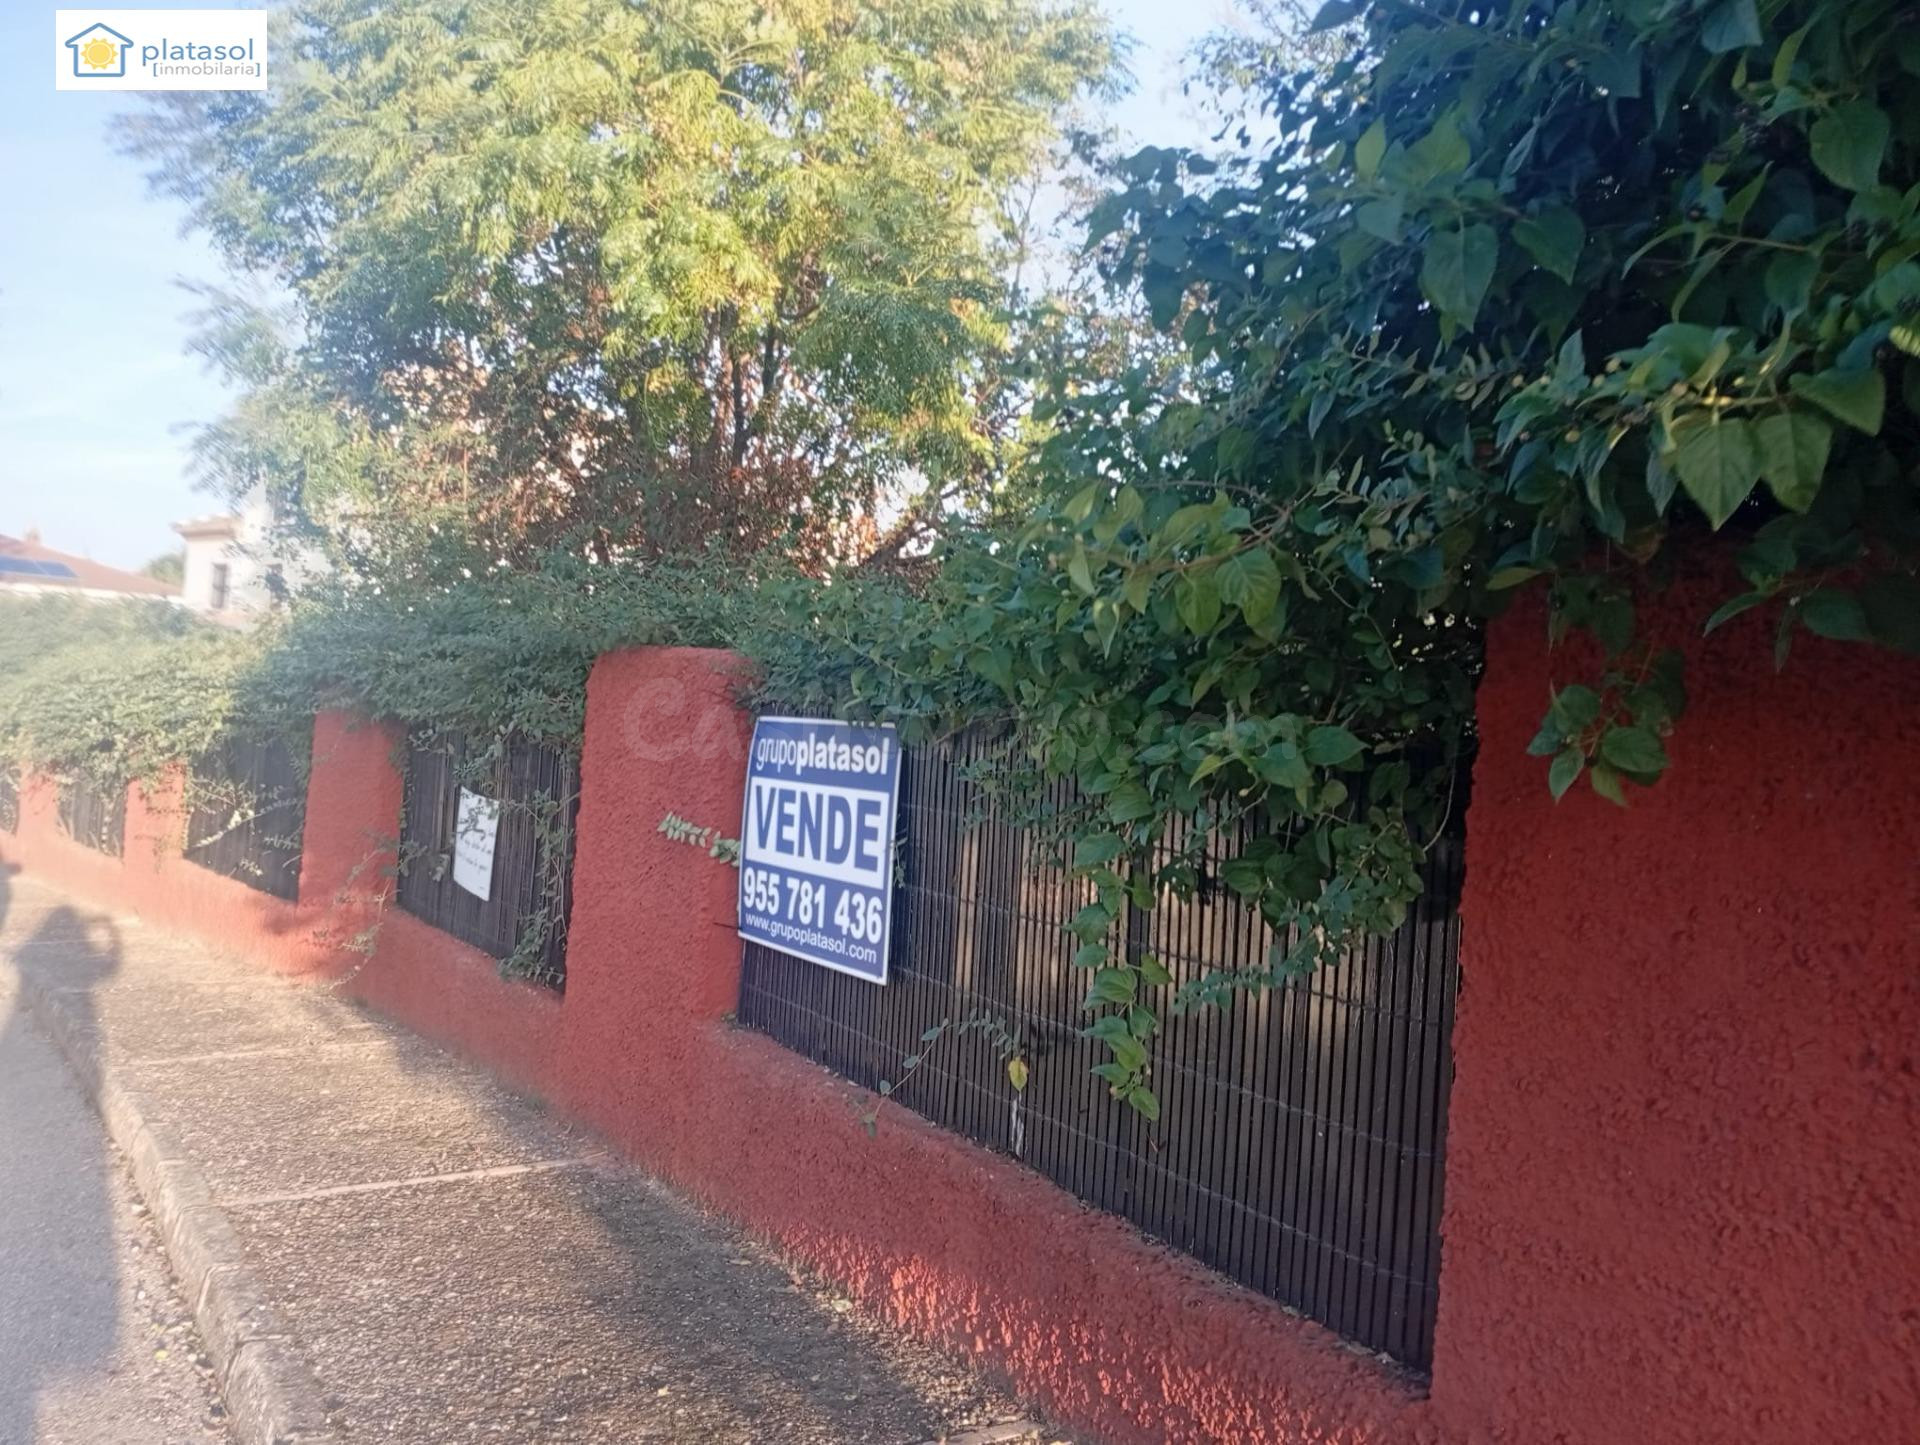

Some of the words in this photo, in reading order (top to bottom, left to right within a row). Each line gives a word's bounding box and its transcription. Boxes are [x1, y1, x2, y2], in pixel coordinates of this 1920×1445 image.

[756, 733, 889, 775] grupoplatasol
[755, 785, 882, 873] VENDE
[744, 867, 780, 915] 955
[787, 878, 826, 928] 781
[834, 889, 883, 944] 436
[745, 913, 877, 964] www.grupoplatasol.com
